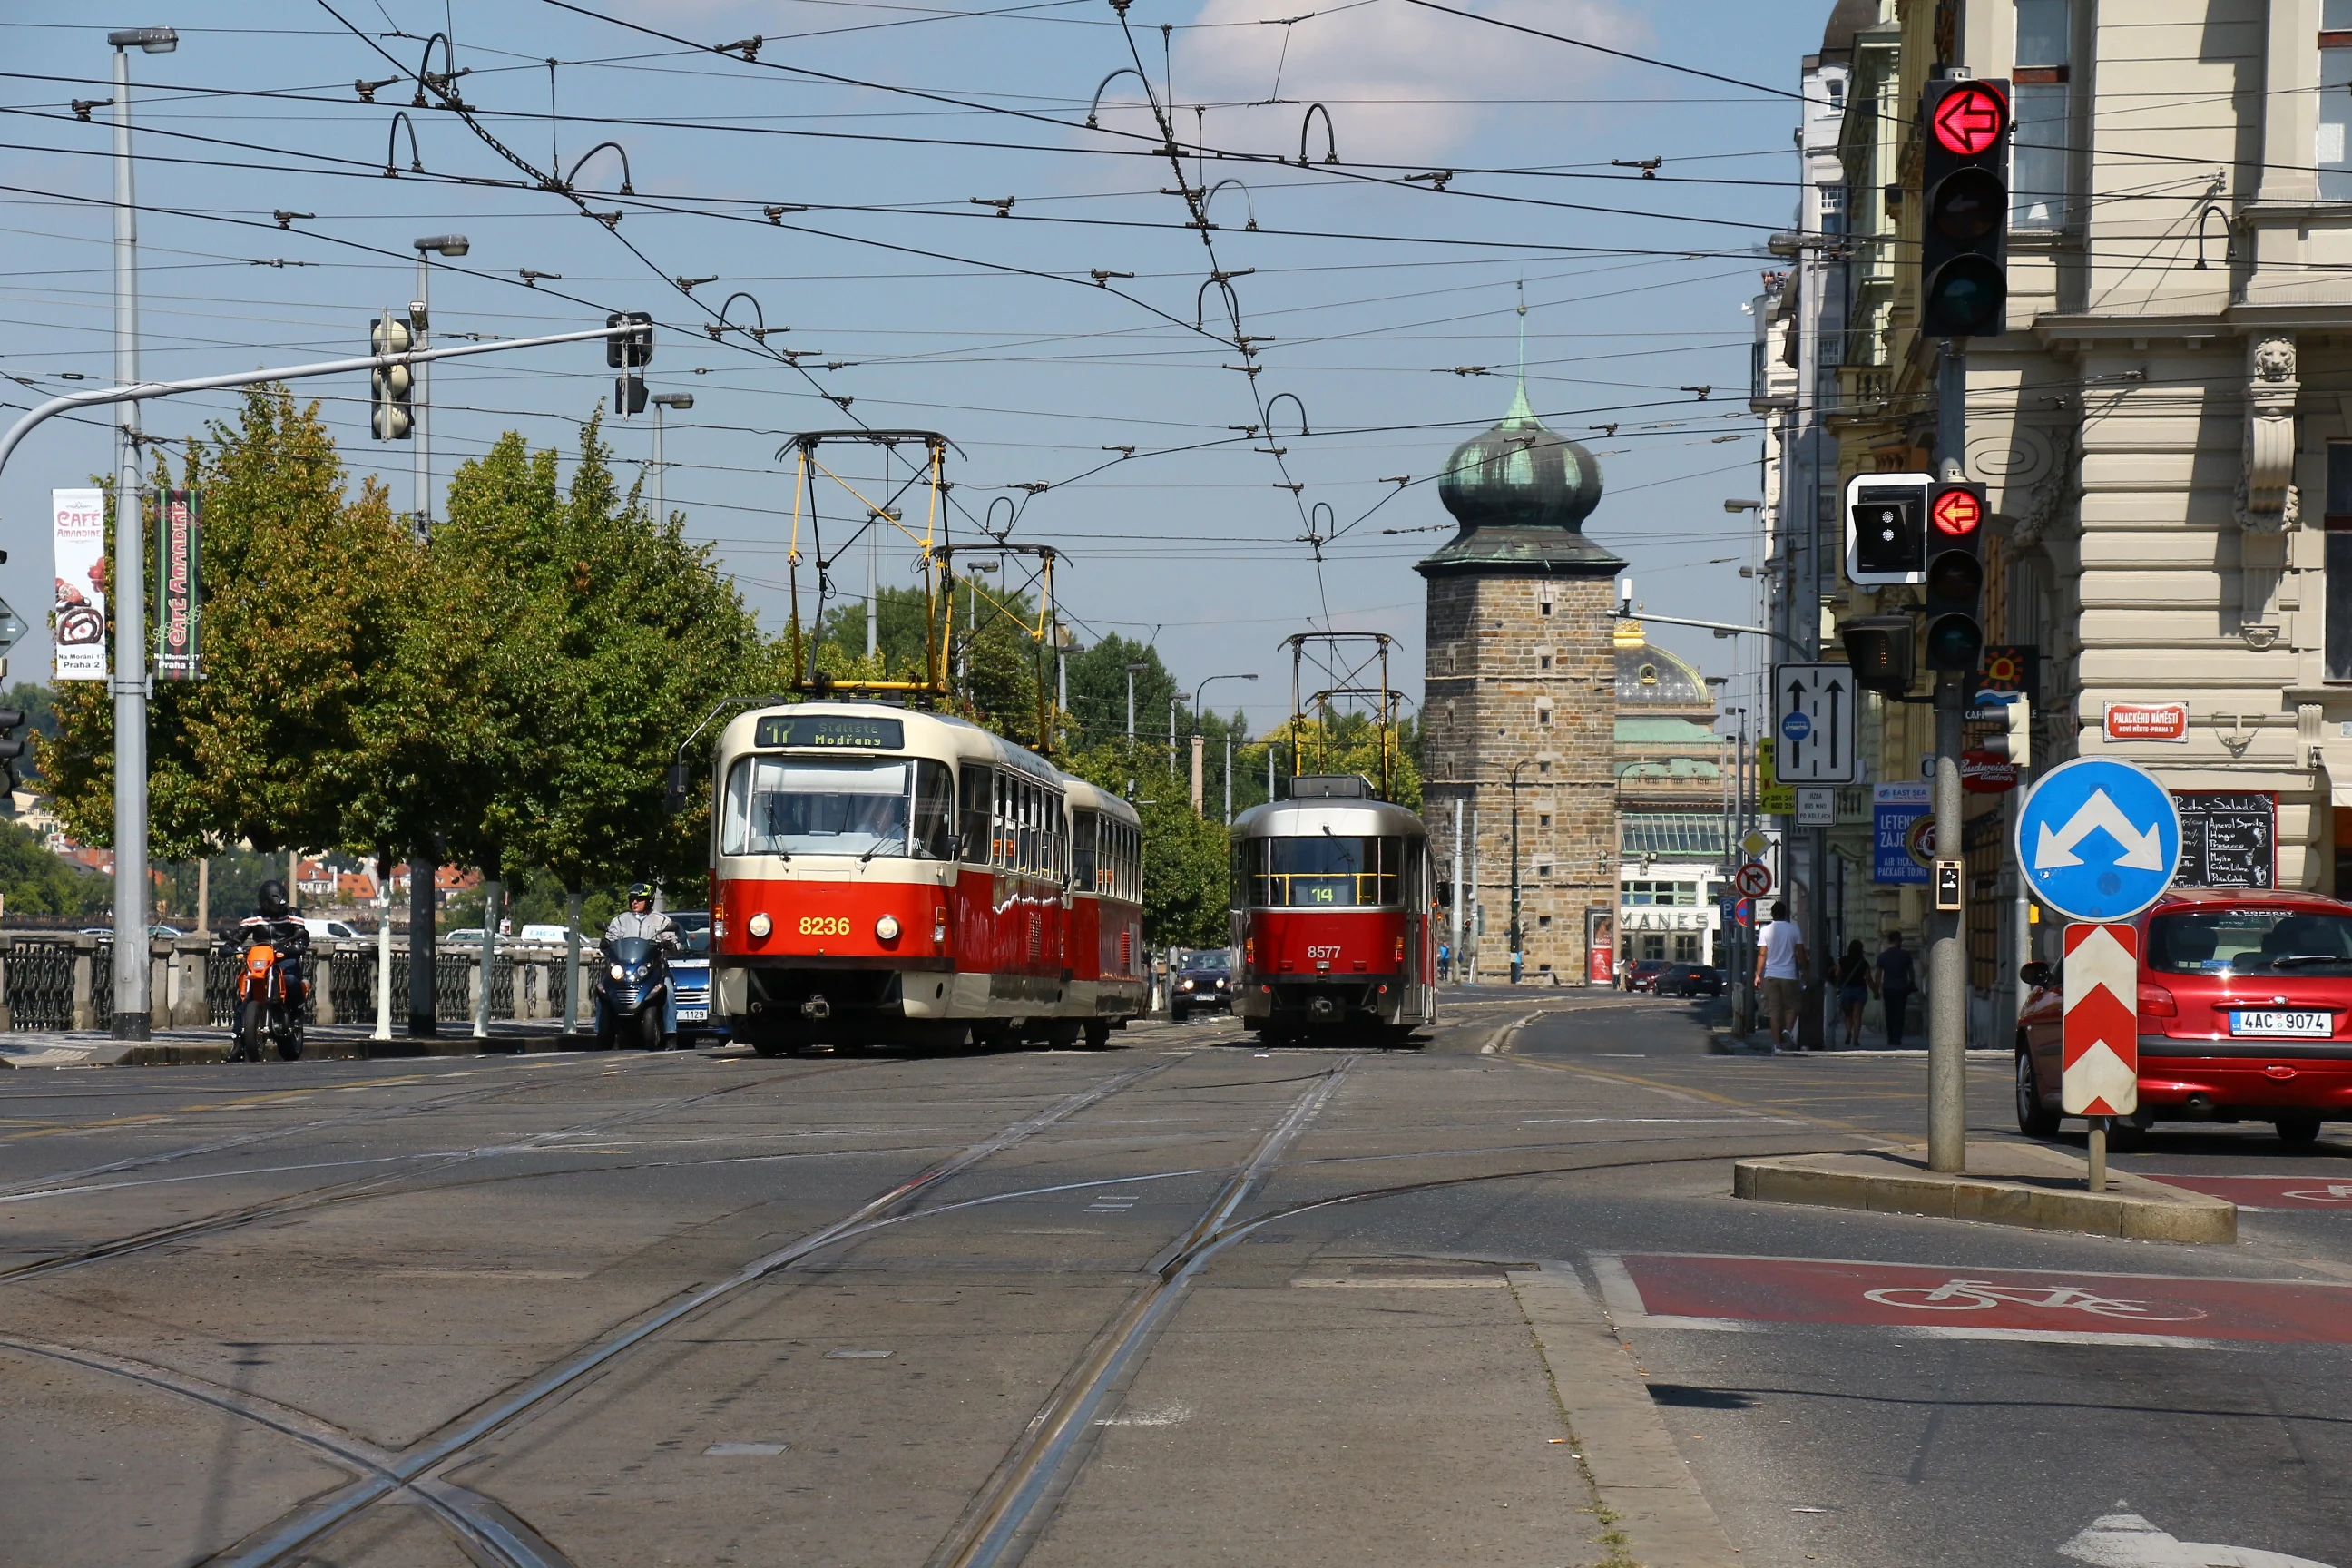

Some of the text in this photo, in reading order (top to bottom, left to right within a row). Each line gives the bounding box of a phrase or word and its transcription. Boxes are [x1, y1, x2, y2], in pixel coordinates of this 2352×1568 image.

[158, 661, 196, 670] Praha 2
[2113, 710, 2180, 724] PALACKÉHO NÁMĚSTÍ
[766, 719, 795, 744] 17
[818, 721, 878, 734] Sídliště
[815, 734, 881, 747] Modřany
[1962, 759, 2014, 772] Budweiser
[1980, 771, 2014, 781] Budvar
[2210, 830, 2235, 841] Hugo
[1311, 888, 1333, 903] 14
[799, 916, 851, 936] 8236
[529, 929, 556, 937] DIGI
[1308, 946, 1341, 959] 8577
[685, 1011, 704, 1019] 1129
[2245, 1014, 2325, 1030] 4AC 9074
